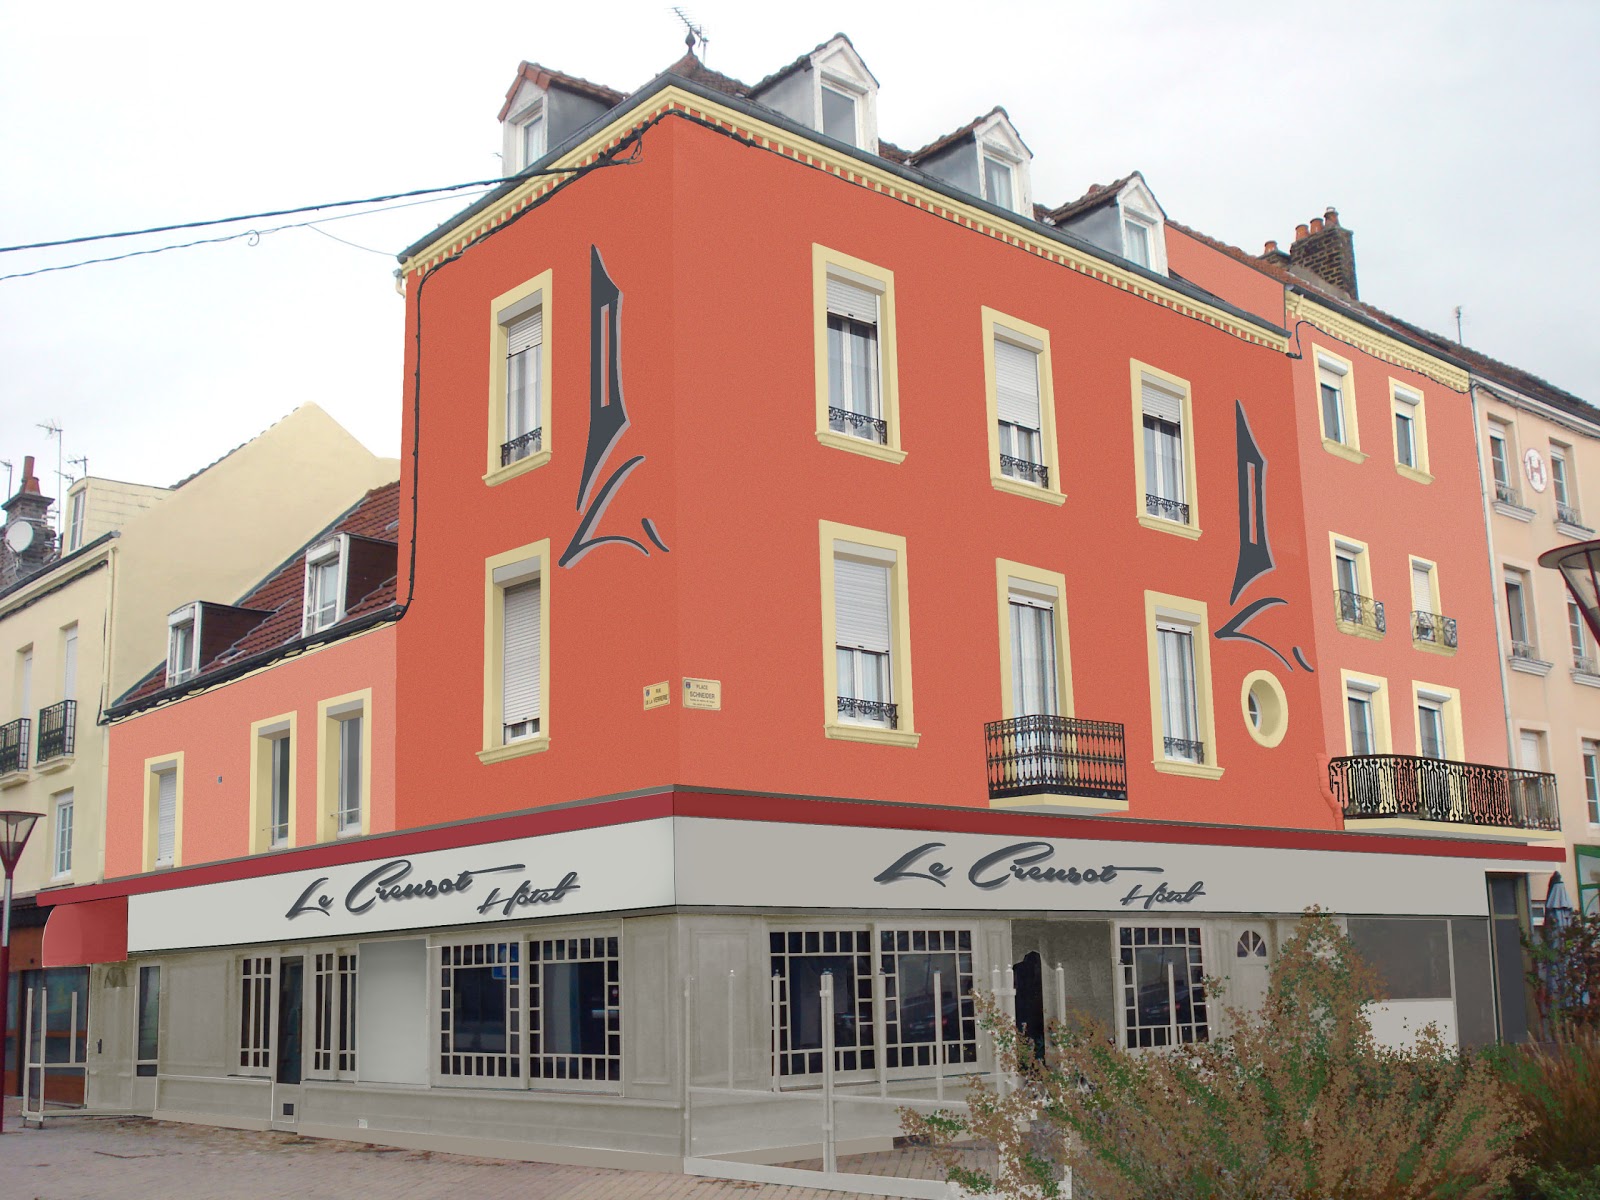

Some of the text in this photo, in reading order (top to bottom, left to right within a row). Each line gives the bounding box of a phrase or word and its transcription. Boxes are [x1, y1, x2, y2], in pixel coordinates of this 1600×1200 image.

[690, 691, 715, 699] SCHNEIDER
[873, 841, 1164, 888] Le Creusot
[285, 859, 526, 918] Le Creusot
